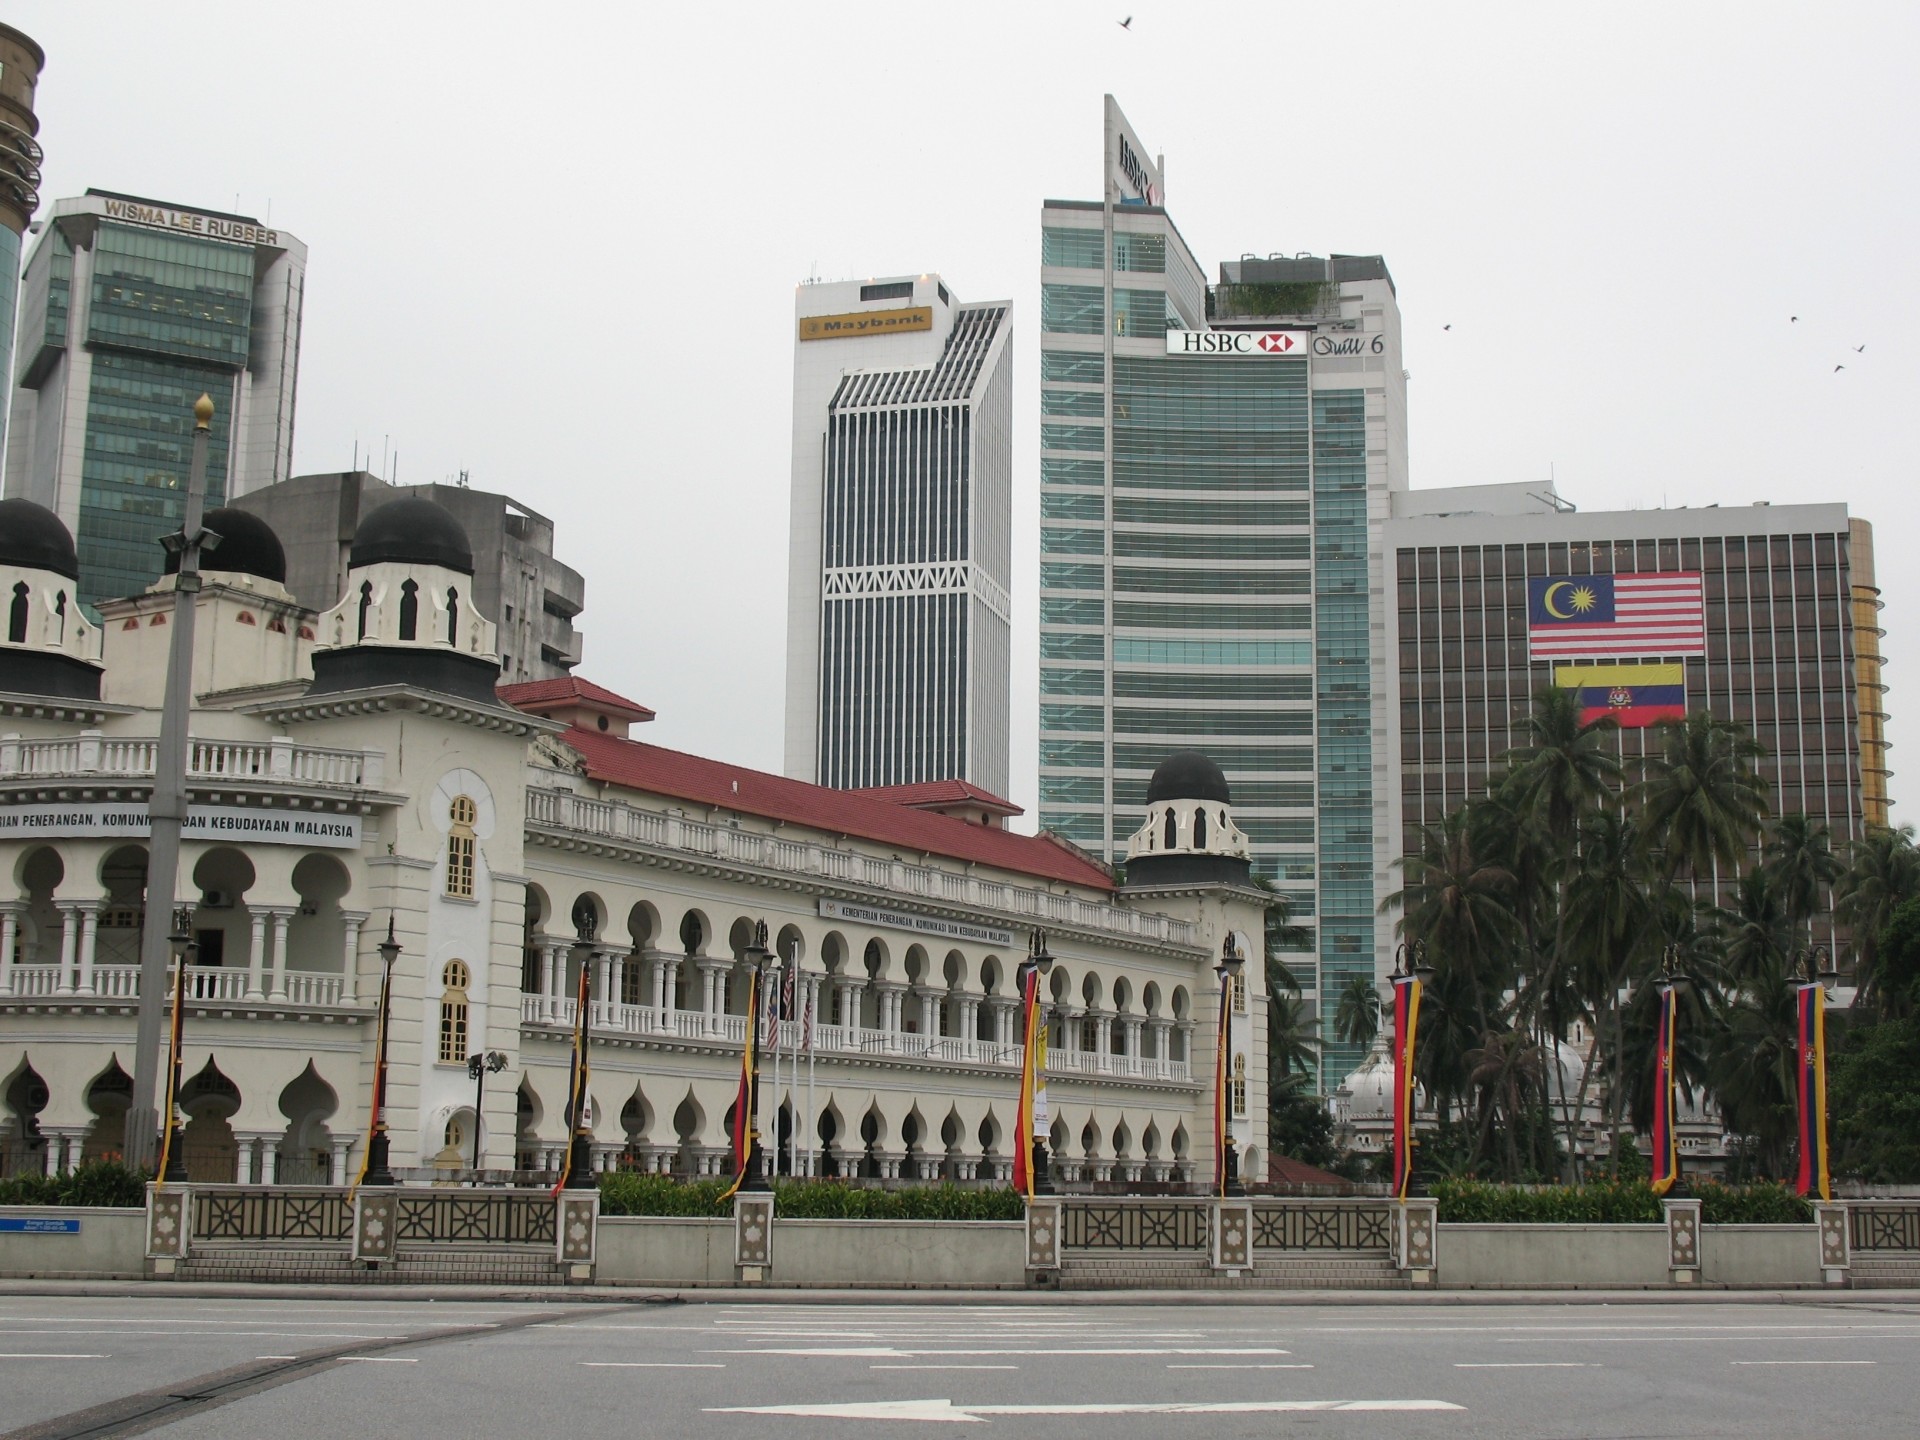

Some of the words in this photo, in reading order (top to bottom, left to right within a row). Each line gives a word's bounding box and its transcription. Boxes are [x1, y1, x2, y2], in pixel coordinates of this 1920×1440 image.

[1120, 133, 1149, 204] HSBC
[104, 199, 166, 225] WISMA
[170, 211, 203, 232] LEE
[207, 218, 278, 245] RUBBER
[823, 314, 925, 331] Maybank
[1183, 333, 1252, 353] HSBC
[1313, 336, 1366, 356] Quill
[1371, 334, 1384, 354] 6
[22, 813, 97, 827] PENERANGAN,
[182, 816, 206, 828] DAN
[211, 816, 289, 833] KEBUDAYAAN
[295, 821, 353, 838] MALAYSIA
[841, 906, 878, 922] KEMENTERIAN
[916, 919, 947, 933] KOMUNIKASI
[948, 924, 958, 935] DAN
[959, 926, 988, 940] KEBUDAYAAN
[988, 931, 1010, 943] MALAYSIA
